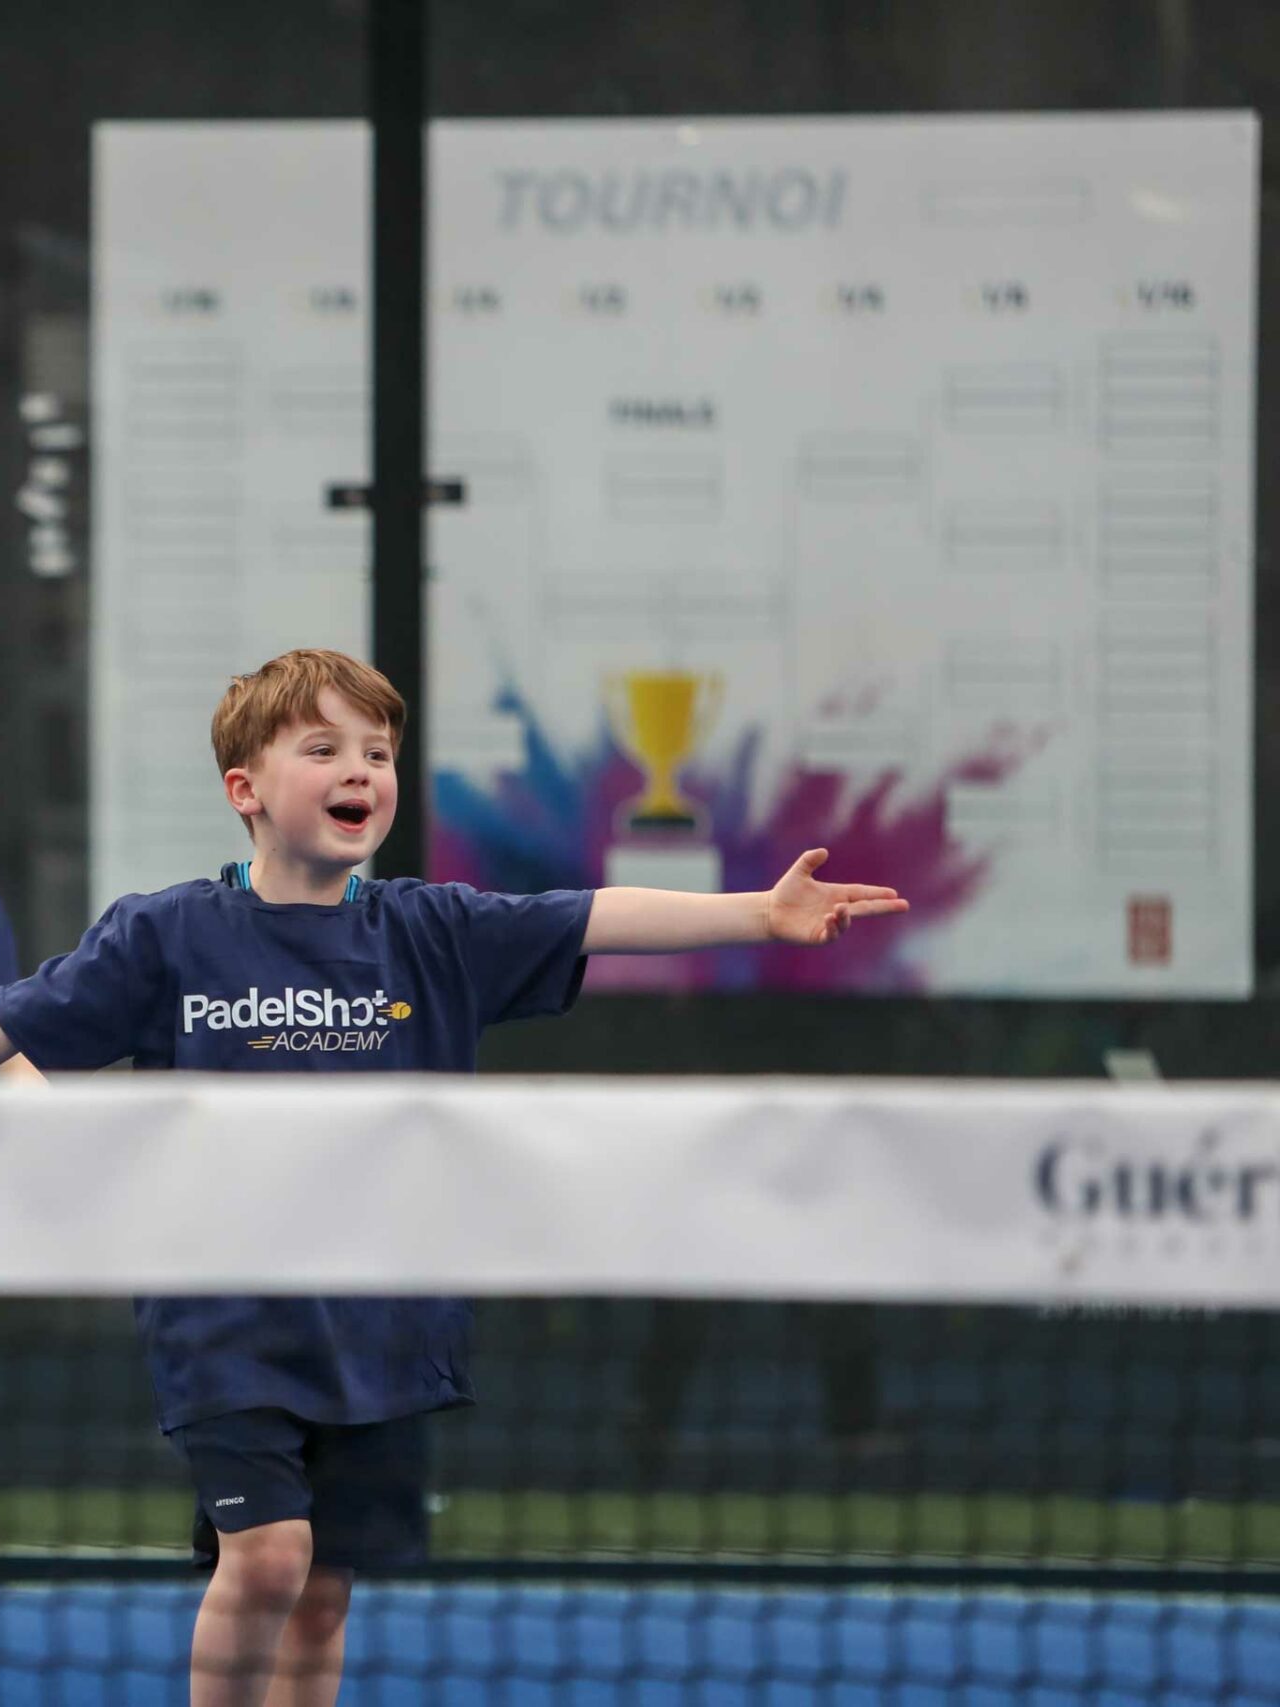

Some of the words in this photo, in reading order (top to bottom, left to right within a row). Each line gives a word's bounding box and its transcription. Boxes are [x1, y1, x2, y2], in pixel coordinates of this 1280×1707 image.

[494, 164, 851, 234] TOURNOI
[183, 987, 388, 1033] PadelShot
[272, 1031, 389, 1051] ACADEMY
